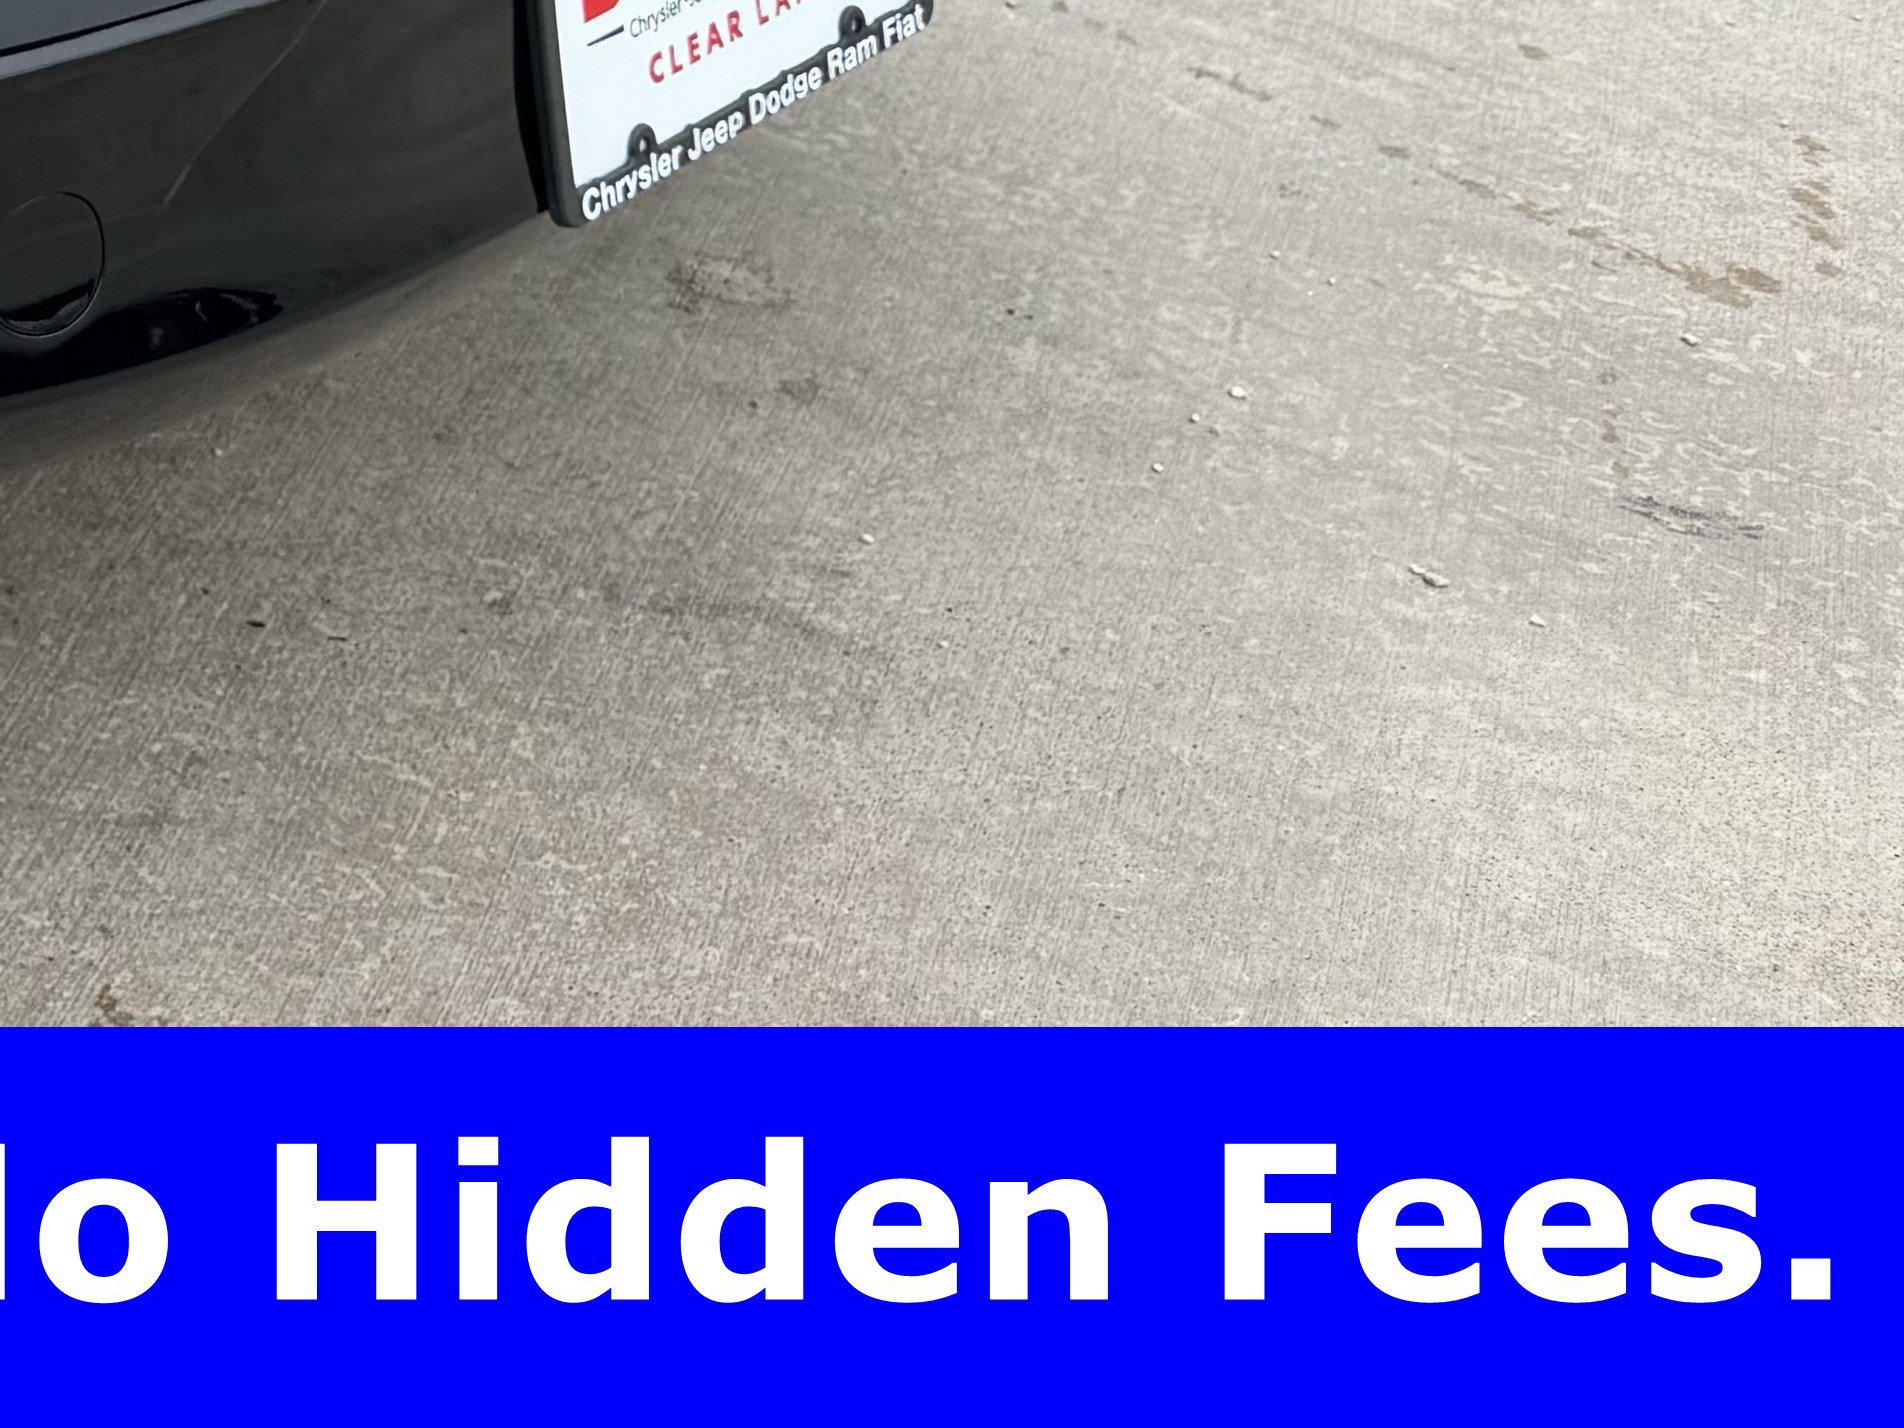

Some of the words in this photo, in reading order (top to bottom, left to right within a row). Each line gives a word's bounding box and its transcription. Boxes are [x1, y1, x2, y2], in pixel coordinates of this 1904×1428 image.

[582, 143, 684, 221] Chrysler
[687, 109, 743, 161] Jeep
[748, 64, 823, 126] Dodge
[827, 31, 878, 80] Ram
[882, 2, 927, 49] Fiat
[648, 9, 743, 84] CLEAR
